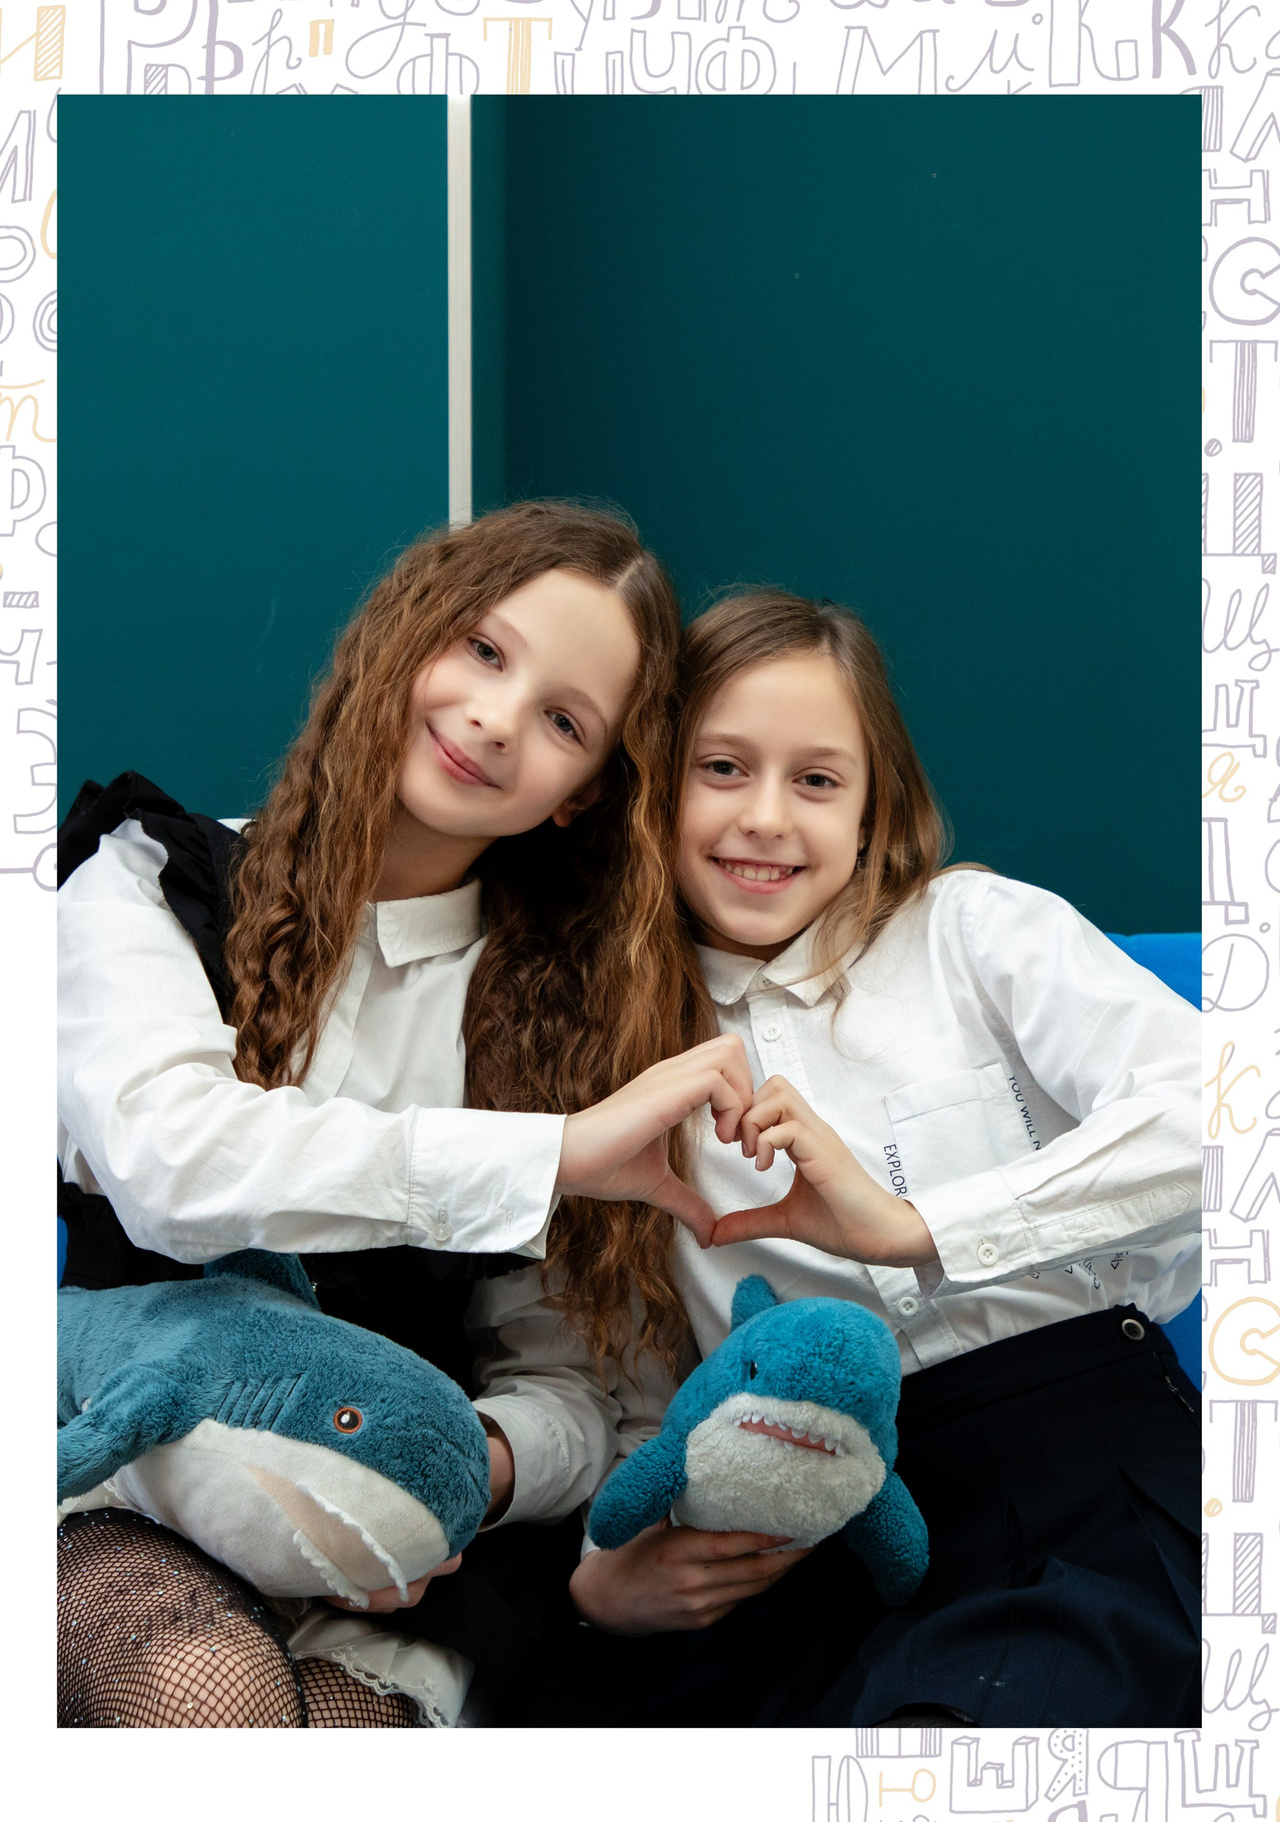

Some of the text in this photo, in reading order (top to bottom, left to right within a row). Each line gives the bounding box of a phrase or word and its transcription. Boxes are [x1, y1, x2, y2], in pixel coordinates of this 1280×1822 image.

[1008, 1075, 1024, 1104] YOU
[1020, 1104, 1036, 1138] WILL
[883, 1143, 908, 1197] EXPLOR
